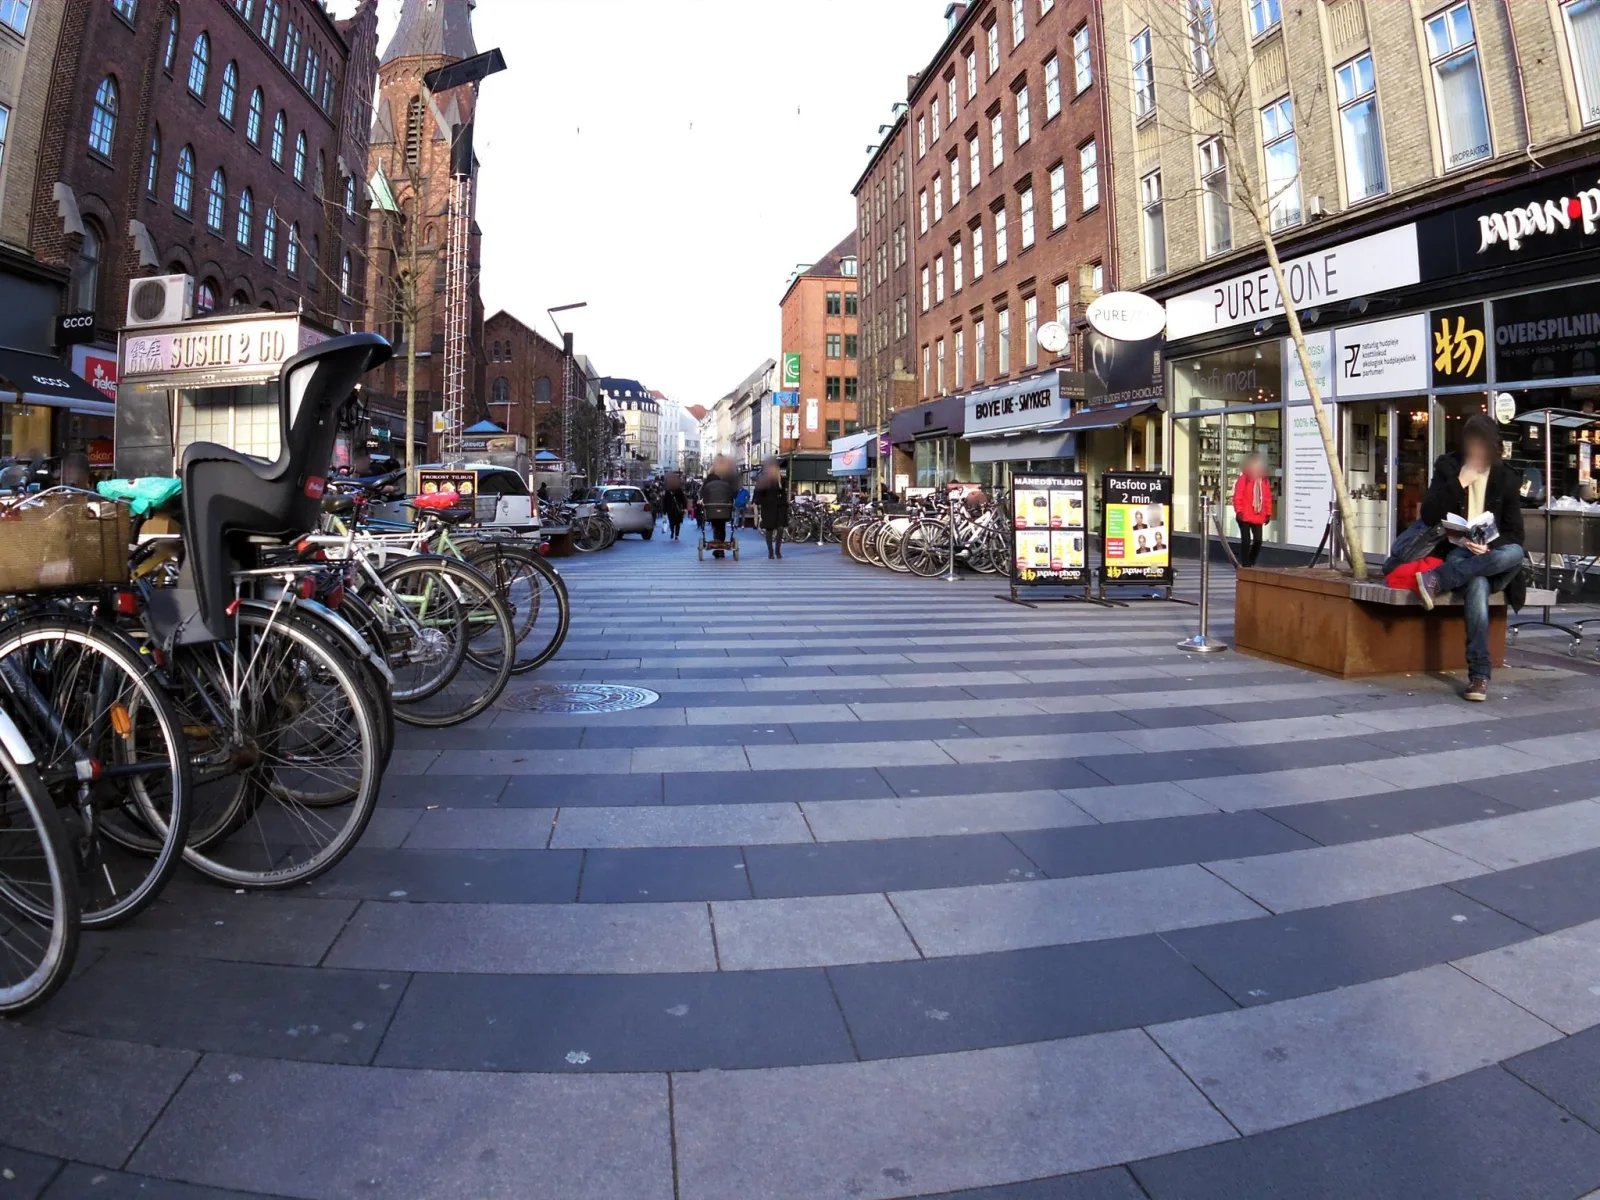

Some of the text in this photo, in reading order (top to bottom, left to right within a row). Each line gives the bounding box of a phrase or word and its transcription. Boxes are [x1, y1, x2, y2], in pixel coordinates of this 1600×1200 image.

[63, 316, 93, 329] ecco
[170, 333, 232, 369] SUSHI
[238, 332, 250, 364] 2
[258, 330, 285, 363] GO
[976, 400, 1001, 420] BOYE
[1014, 477, 1083, 486] MÅNEDSTILBUD
[1110, 479, 1162, 492] Pasfoto på
[1121, 493, 1153, 504] 2 min.
